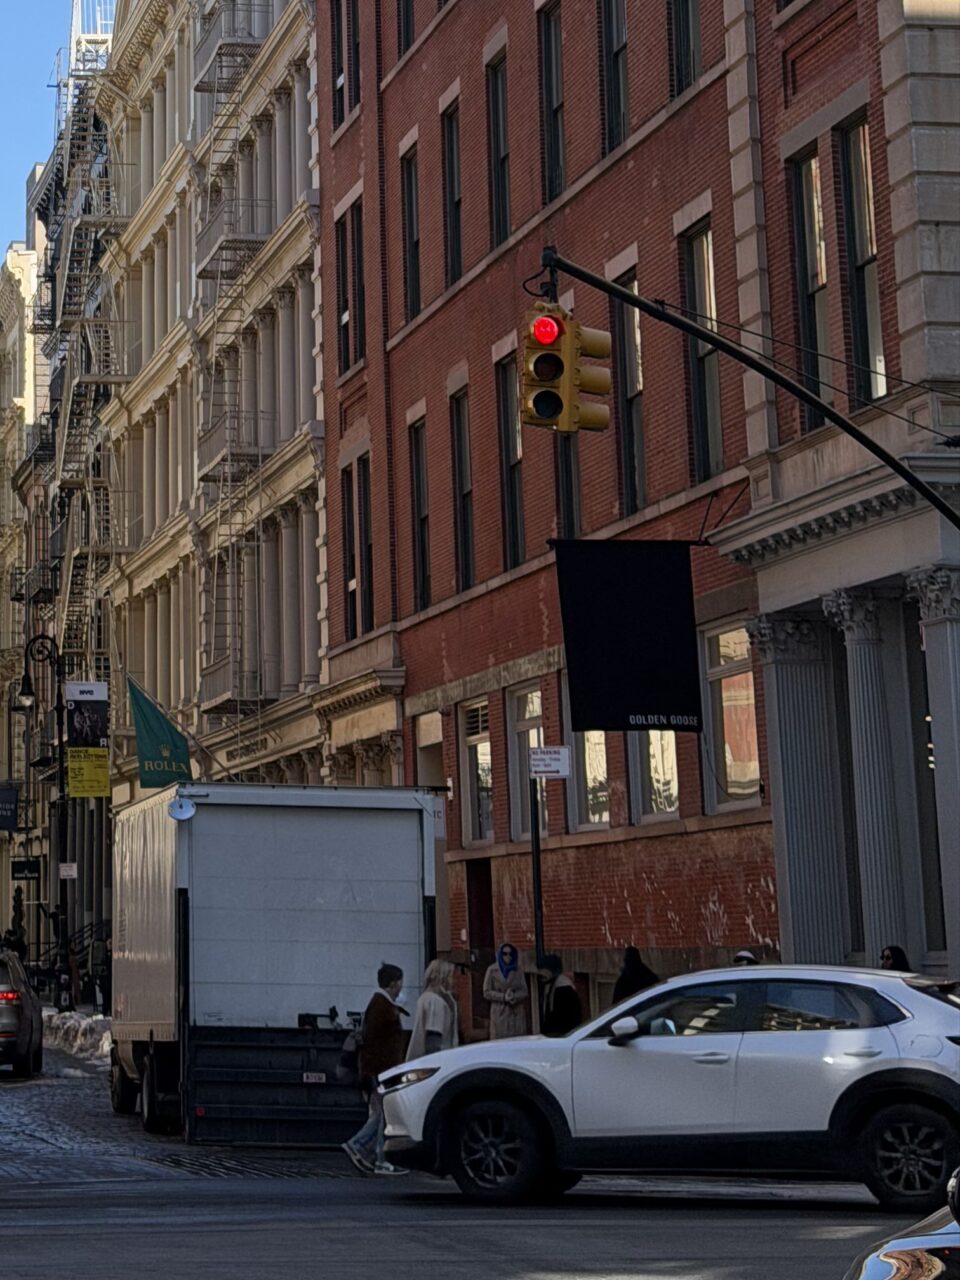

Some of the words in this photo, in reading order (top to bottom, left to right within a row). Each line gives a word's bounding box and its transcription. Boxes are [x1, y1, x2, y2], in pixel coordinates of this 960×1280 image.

[629, 714, 667, 725] GOLDEN
[670, 715, 698, 726] GOOSE
[144, 760, 188, 773] ROLEX
